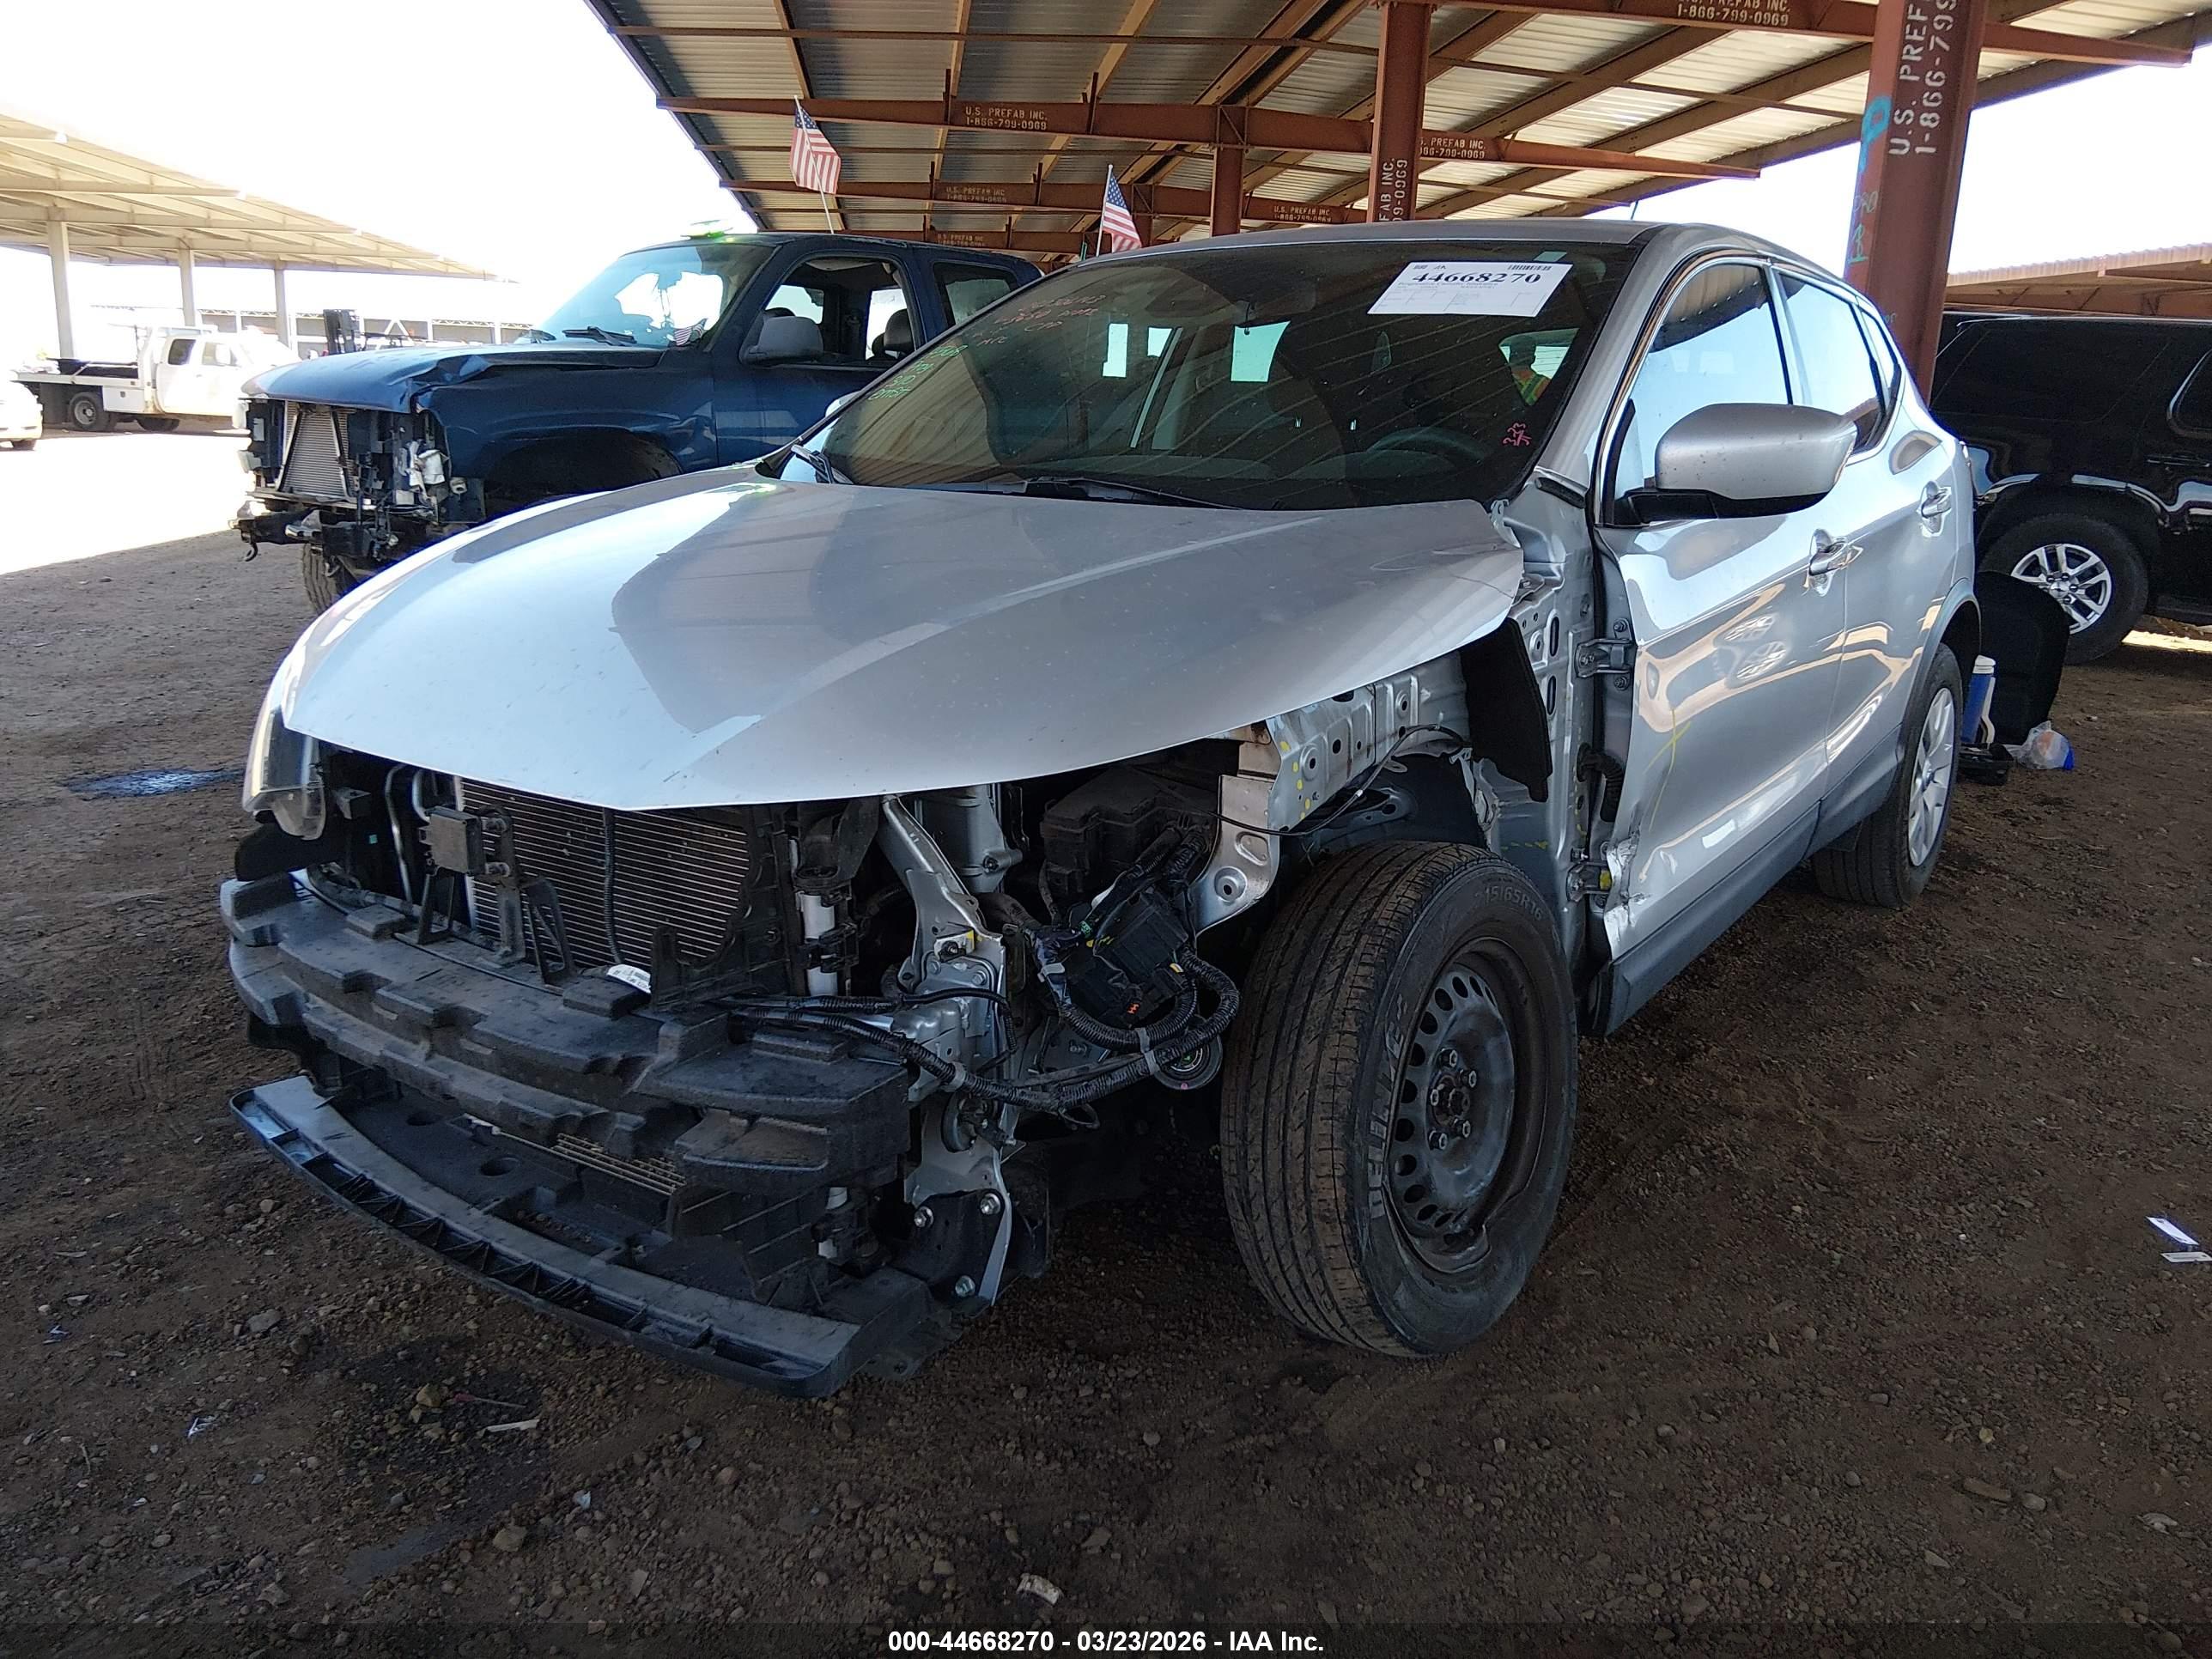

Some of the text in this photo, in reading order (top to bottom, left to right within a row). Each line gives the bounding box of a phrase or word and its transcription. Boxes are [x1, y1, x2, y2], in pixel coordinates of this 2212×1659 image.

[1677, 3, 1789, 26] 1-866-799-0969
[1889, 0, 1931, 155] U.S. PREF
[989, 107, 1025, 118] PREFAB
[1030, 110, 1048, 121] INC.
[1431, 137, 1465, 149] PREFAB
[1469, 139, 1486, 149] INC.
[1381, 158, 1395, 185] INC.
[1413, 272, 1541, 283] 44668270
